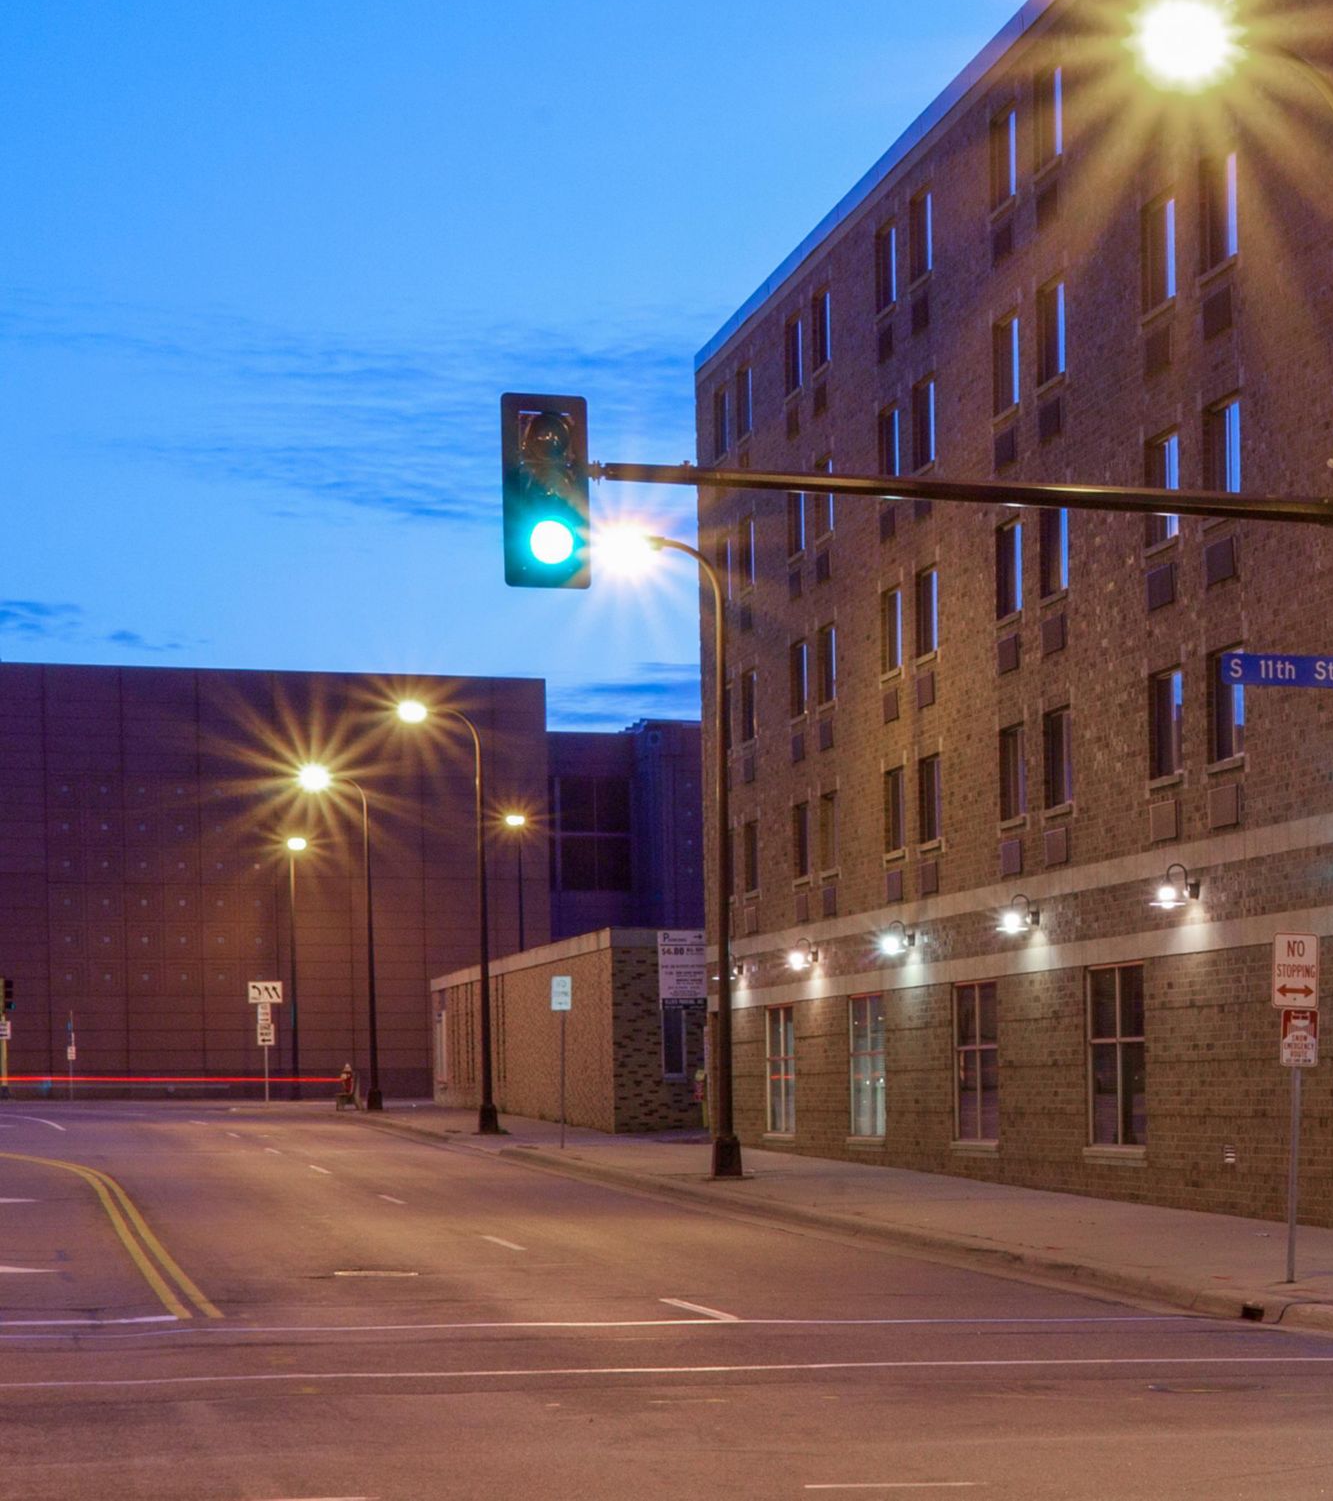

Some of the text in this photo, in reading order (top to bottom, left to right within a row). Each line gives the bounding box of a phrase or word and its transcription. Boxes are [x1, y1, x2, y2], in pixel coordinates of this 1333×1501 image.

[1229, 658, 1243, 678] S
[1259, 660, 1296, 680] 11th
[1287, 940, 1305, 957] NO
[1276, 963, 1315, 978] STOPPING
